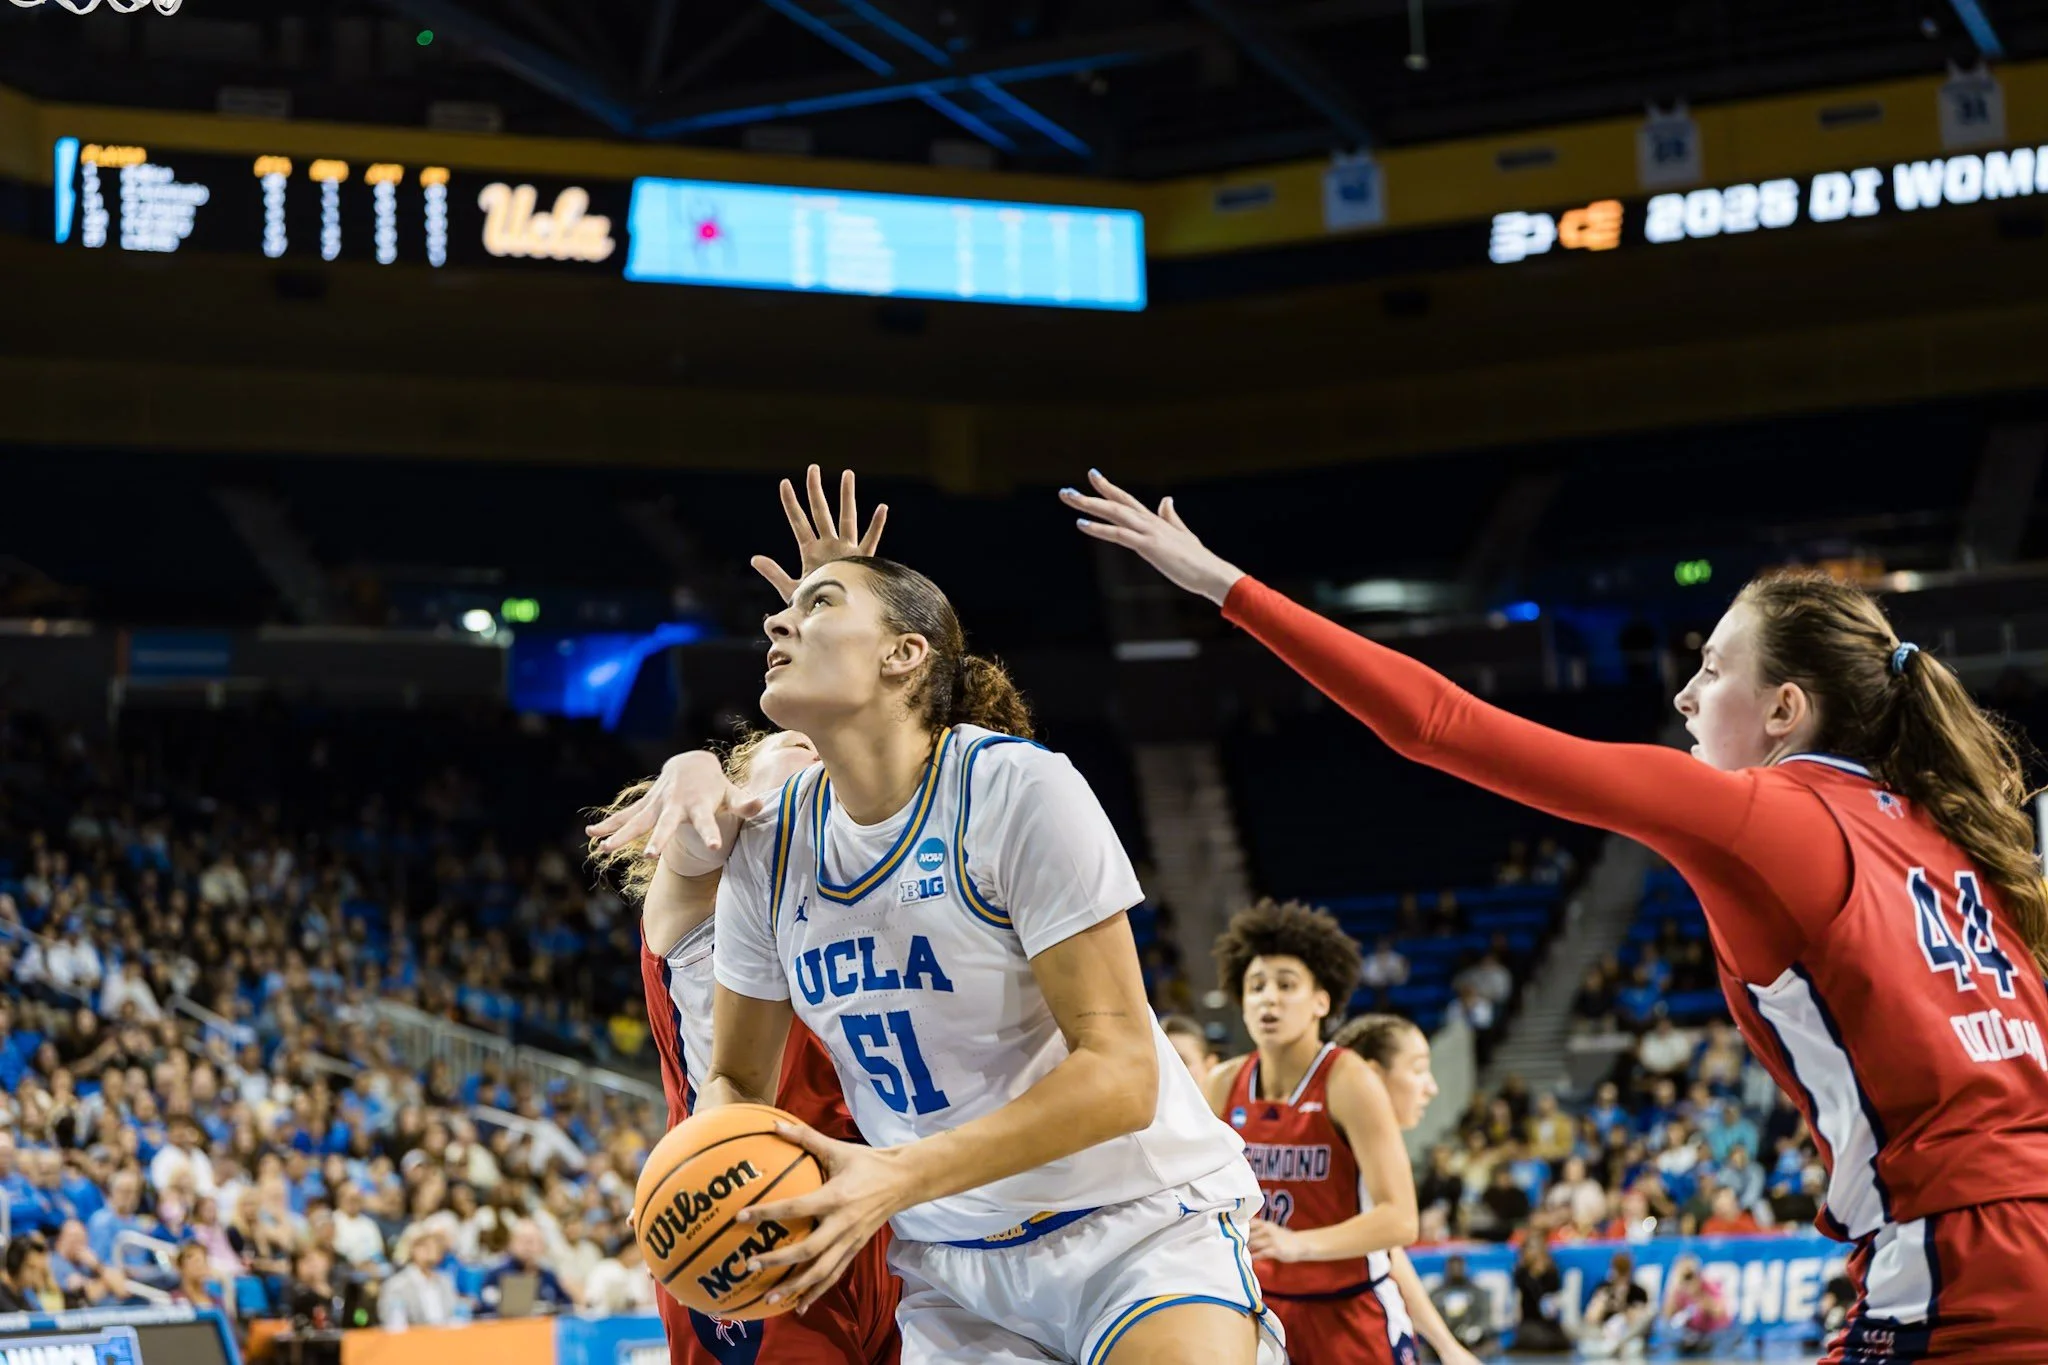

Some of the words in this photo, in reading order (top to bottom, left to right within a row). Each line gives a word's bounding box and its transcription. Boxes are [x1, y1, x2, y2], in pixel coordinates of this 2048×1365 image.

[1645, 178, 1799, 244] 2025
[795, 935, 954, 1006] UCLA
[1906, 866, 2019, 999] 44
[840, 1010, 951, 1115] 51
[645, 1160, 762, 1260] Wilson
[697, 1220, 790, 1299] NCAA
